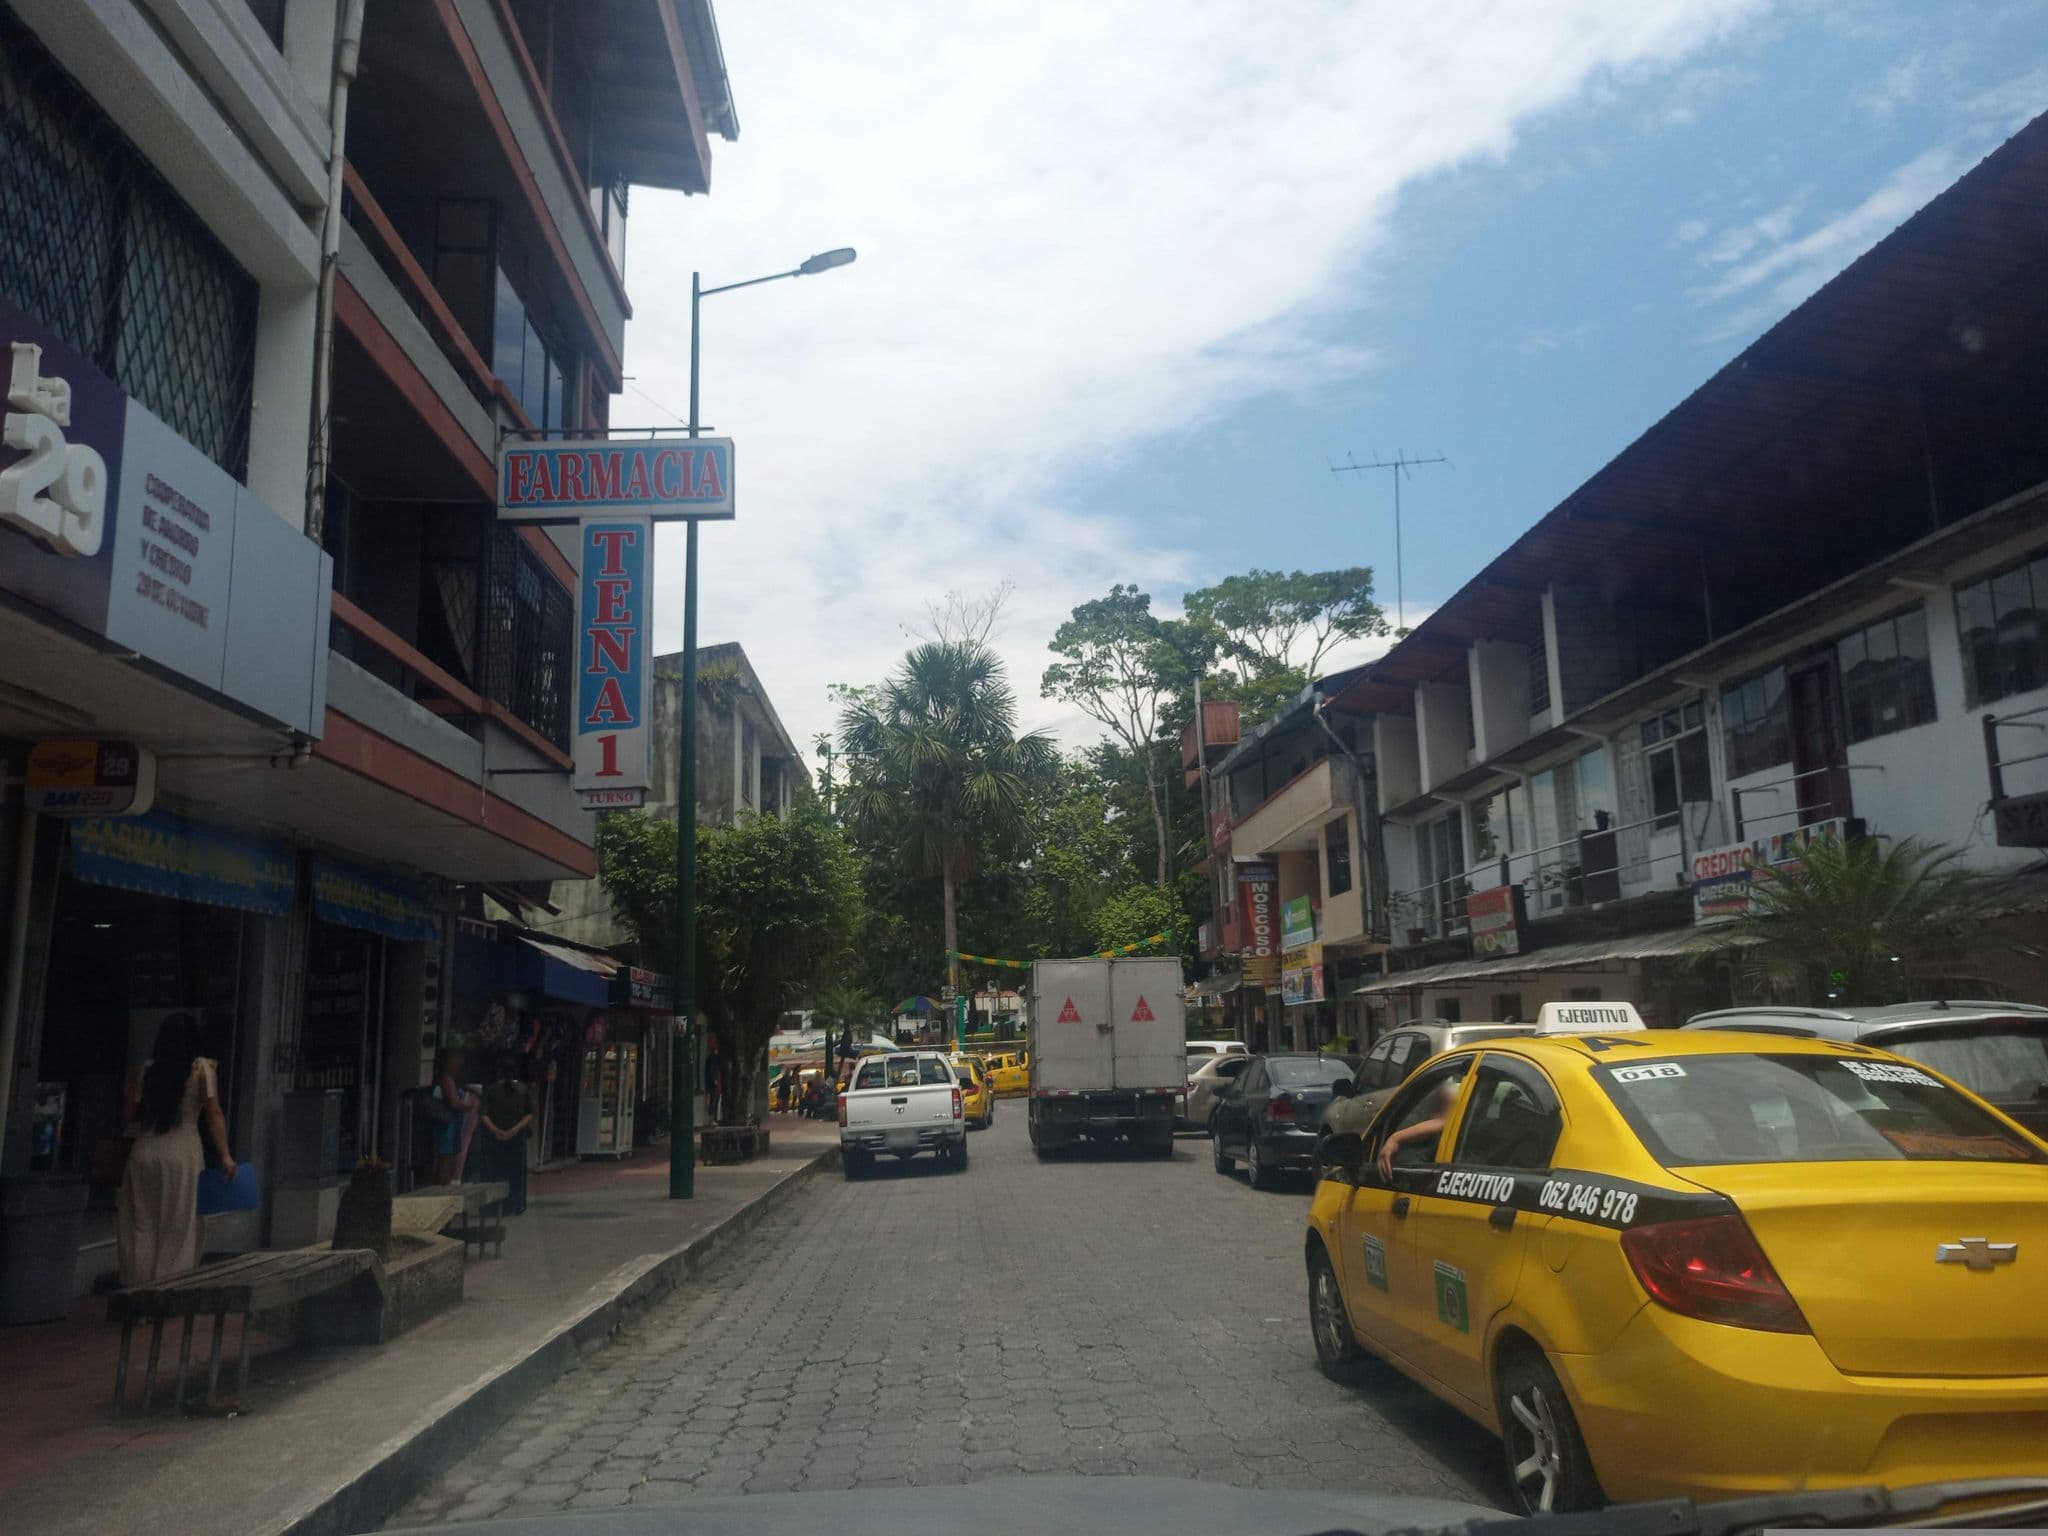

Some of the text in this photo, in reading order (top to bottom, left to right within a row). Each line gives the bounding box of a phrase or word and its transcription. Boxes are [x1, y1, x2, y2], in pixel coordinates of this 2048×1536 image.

[0, 413, 108, 556] 29
[507, 449, 724, 504] FARMACIA
[586, 530, 636, 725] TENA
[594, 733, 624, 778] 1
[587, 791, 634, 805] TURNO
[1252, 883, 1271, 957] MOSCOSO
[1558, 1008, 1629, 1024] EJECUTIVO
[1620, 1067, 1679, 1080] 018
[1437, 1171, 1515, 1203] EJECUTIVO
[1540, 1180, 1639, 1224] 062 846 978
